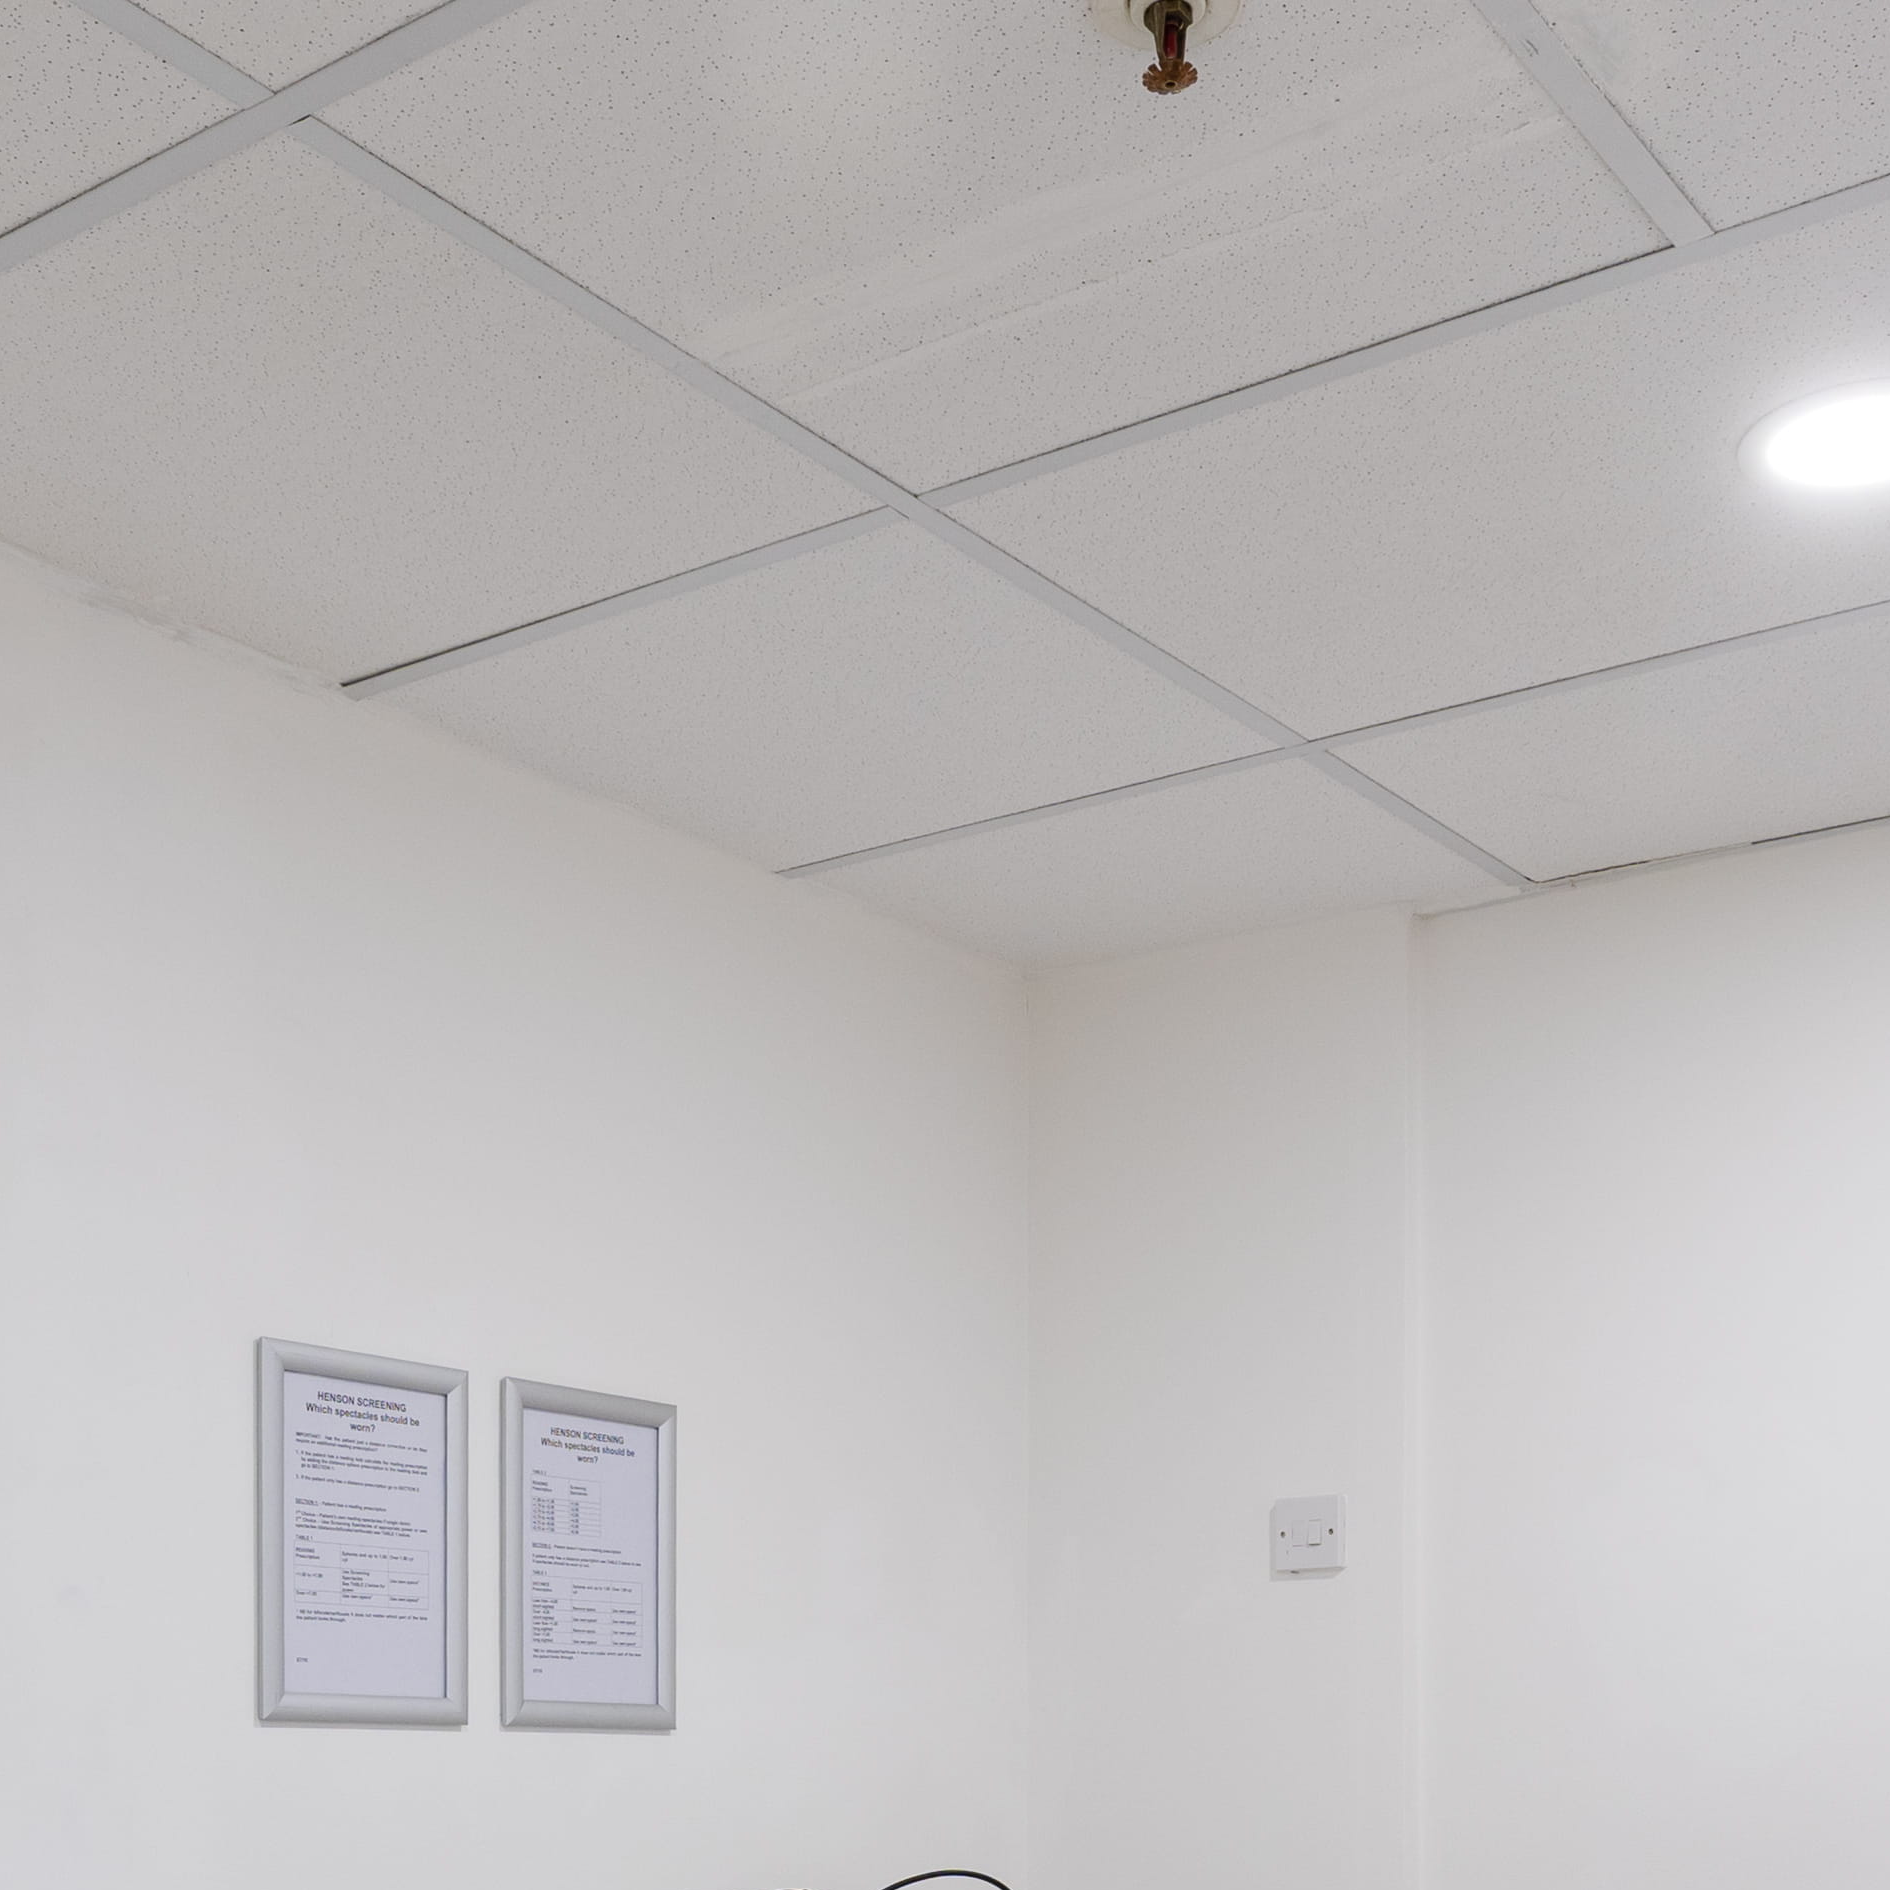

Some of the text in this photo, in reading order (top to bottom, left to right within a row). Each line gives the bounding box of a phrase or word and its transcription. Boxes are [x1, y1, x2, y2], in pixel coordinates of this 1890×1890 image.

[317, 1391, 407, 1412] HENSON SCREENING
[306, 1402, 420, 1426] Which spectacles should be
[350, 1423, 376, 1432] worn?
[550, 1427, 624, 1445] HENSON SCREENING
[541, 1437, 635, 1457] Which spectacles should be
[577, 1456, 598, 1464] worn?
